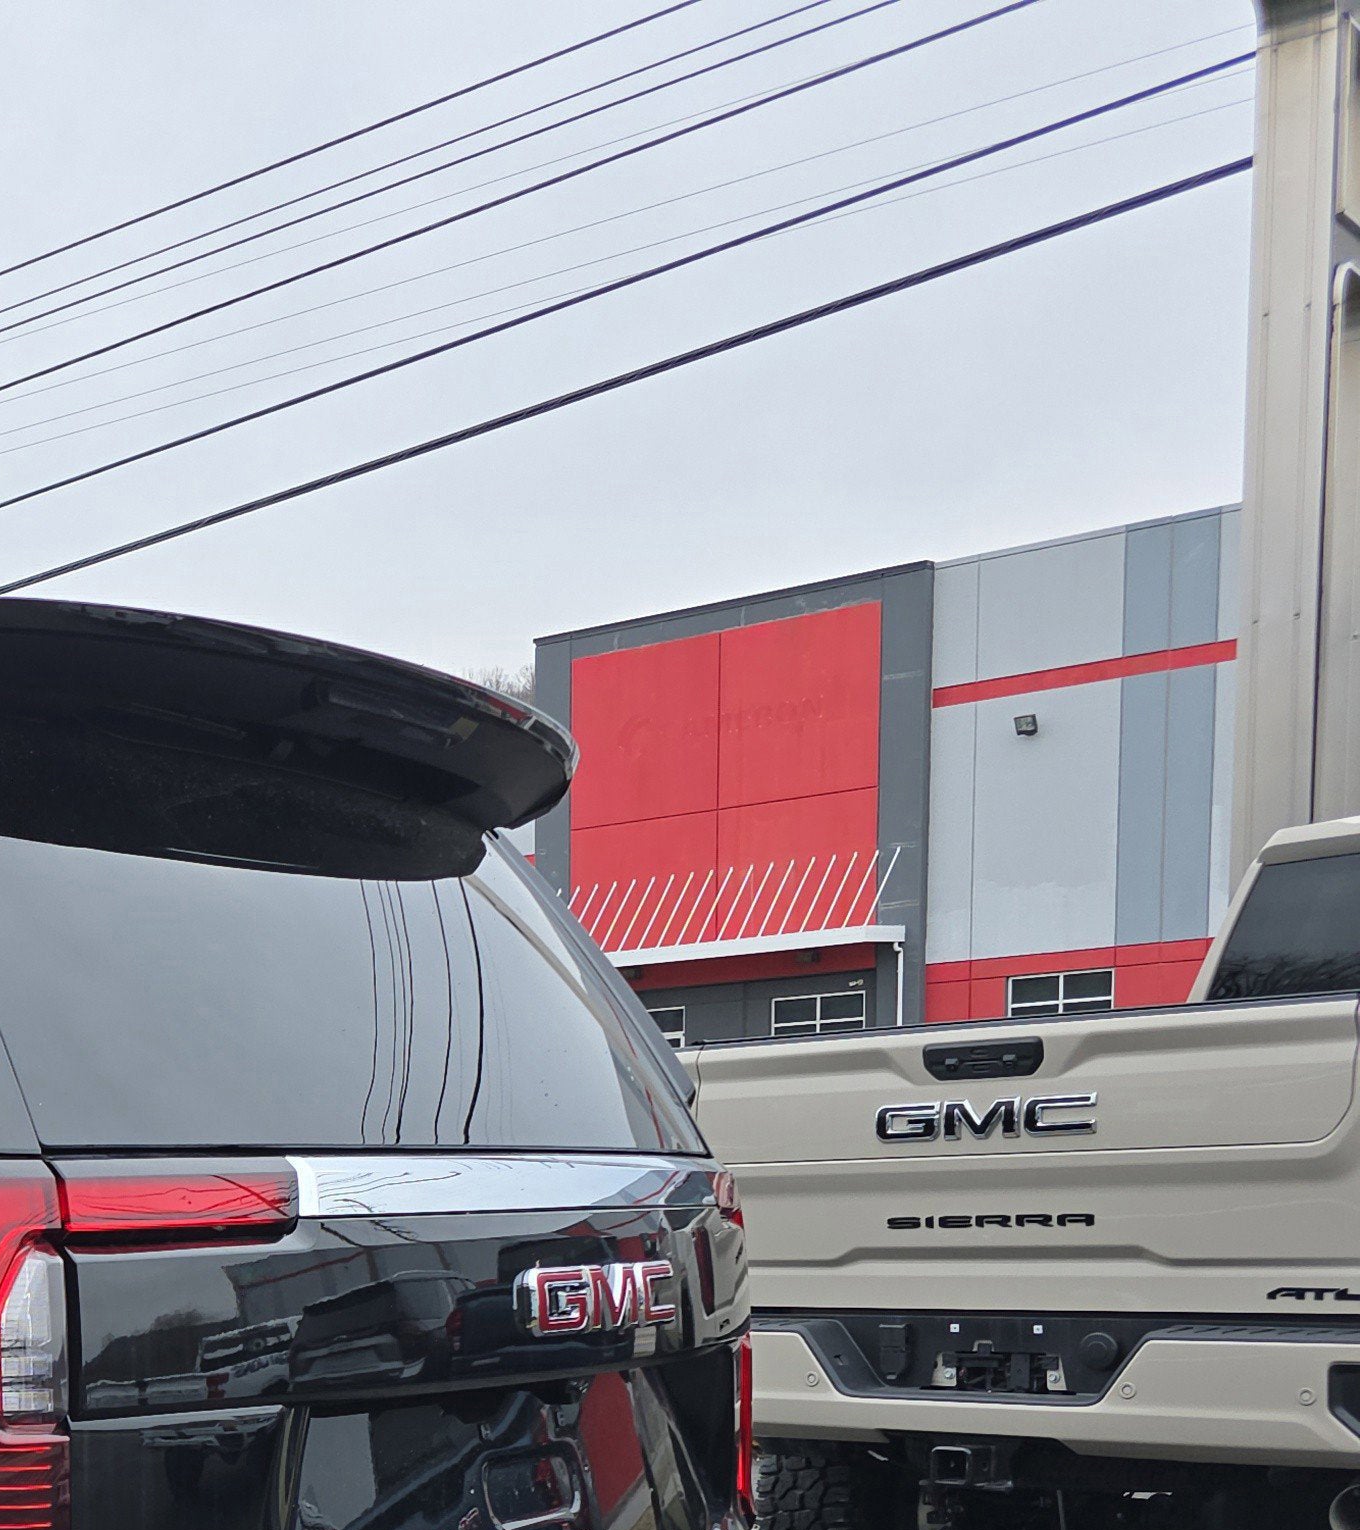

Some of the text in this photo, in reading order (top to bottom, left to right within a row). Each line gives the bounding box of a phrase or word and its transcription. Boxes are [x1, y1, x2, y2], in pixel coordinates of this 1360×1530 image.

[876, 1091, 1097, 1144] GMC
[886, 1213, 1096, 1230] SIERRA
[514, 1260, 676, 1337] GMC
